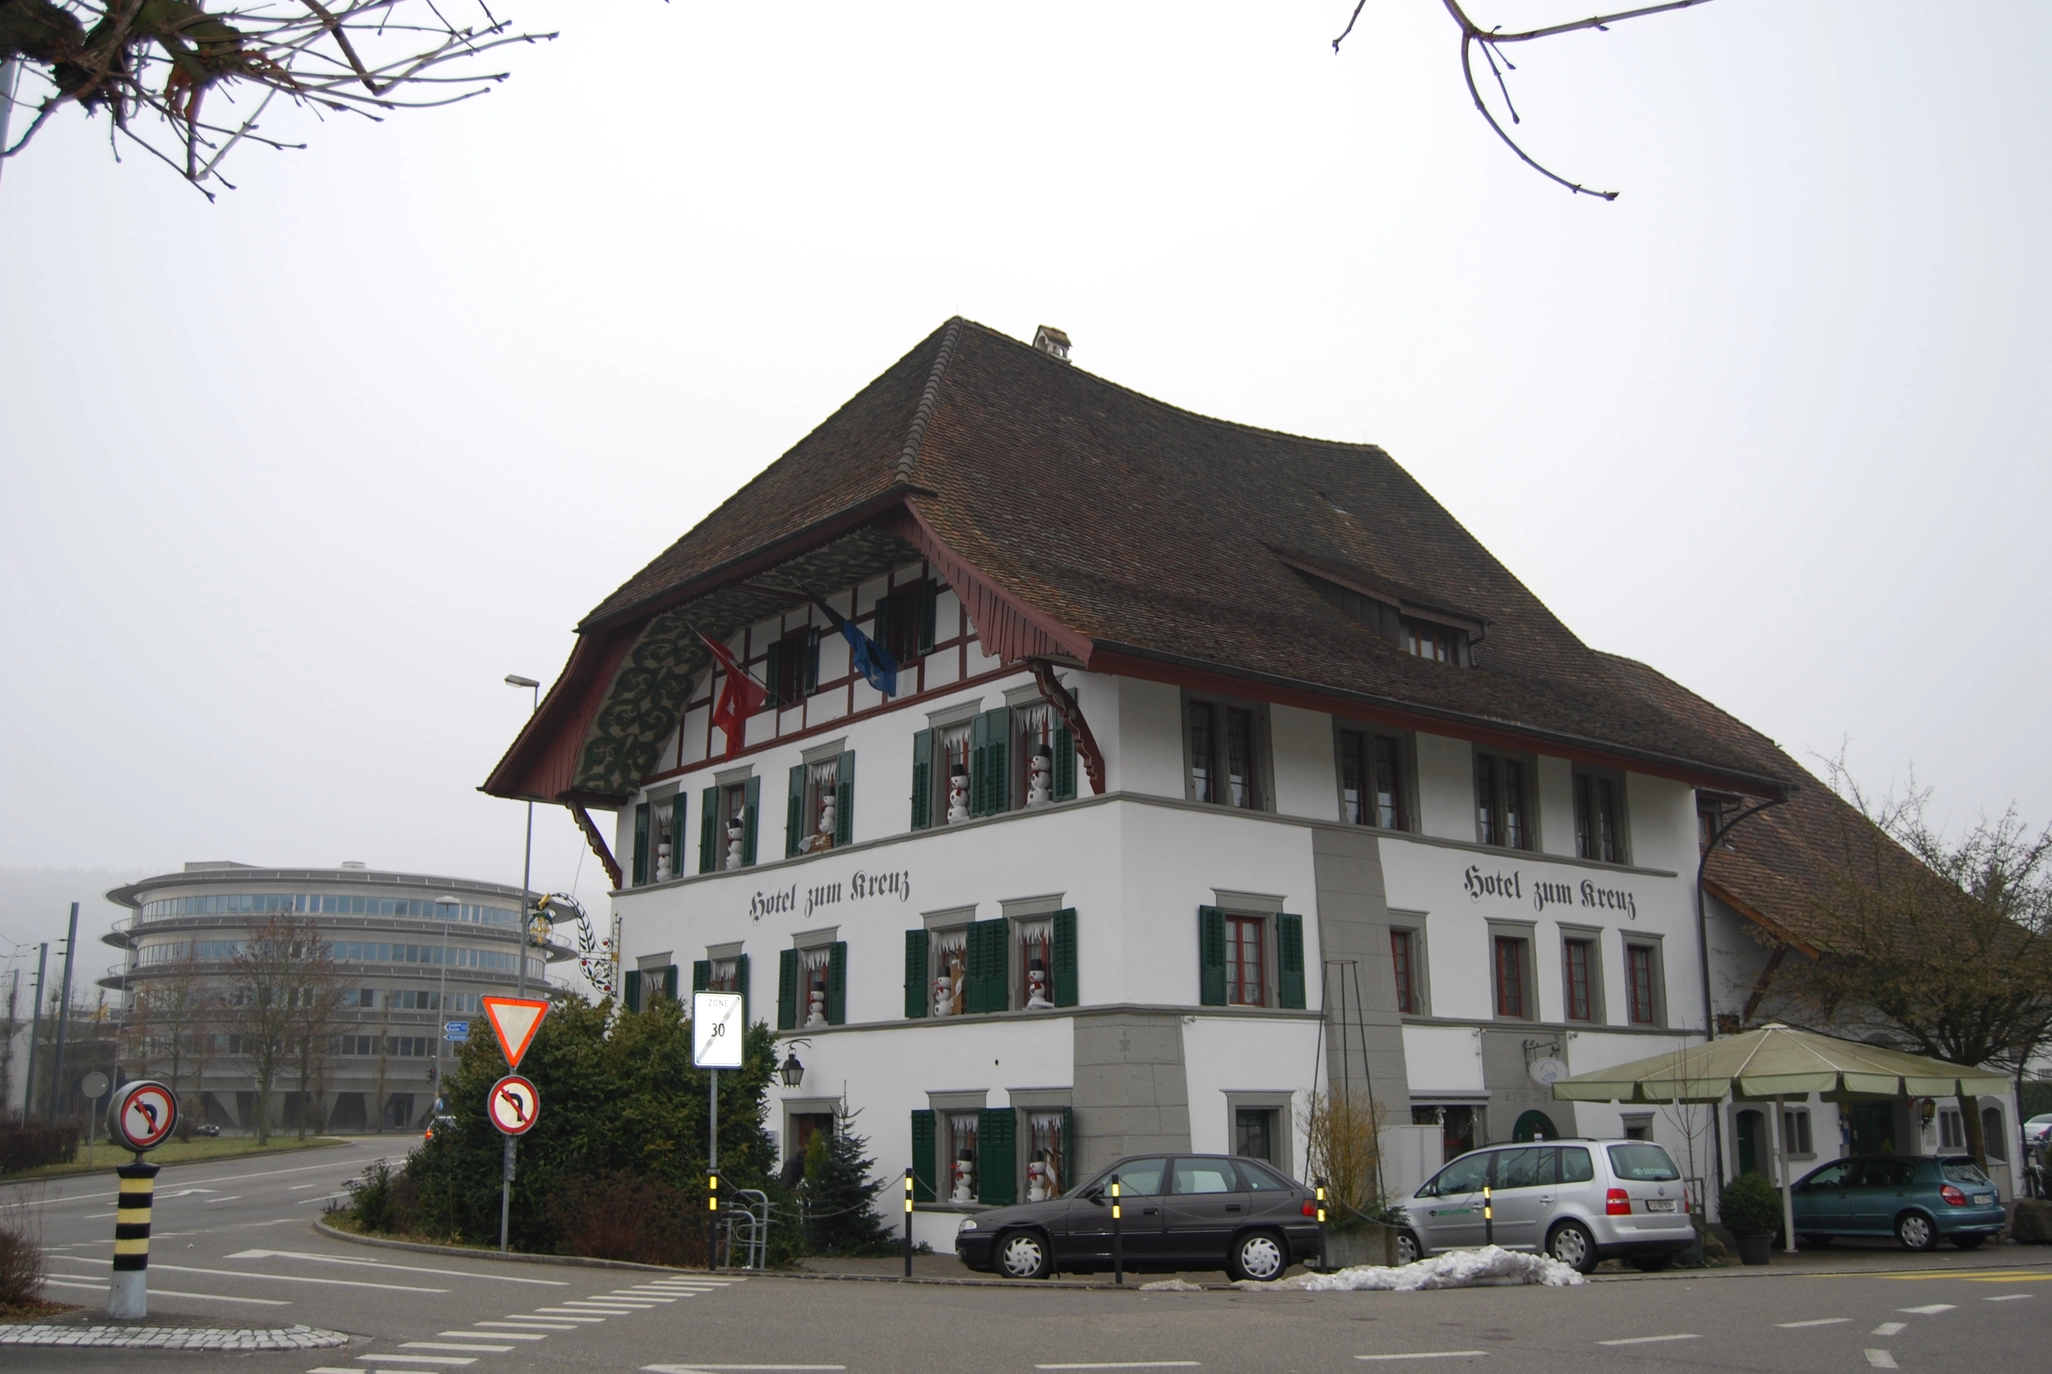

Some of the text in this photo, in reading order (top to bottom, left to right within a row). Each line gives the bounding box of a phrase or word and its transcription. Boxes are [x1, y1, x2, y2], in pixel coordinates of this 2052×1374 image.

[749, 870, 910, 927] Hotel zum Kreuz
[1464, 864, 1636, 920] Hotel zum Kreuz
[708, 999, 729, 1007] ZONE
[711, 1022, 726, 1037] 30
